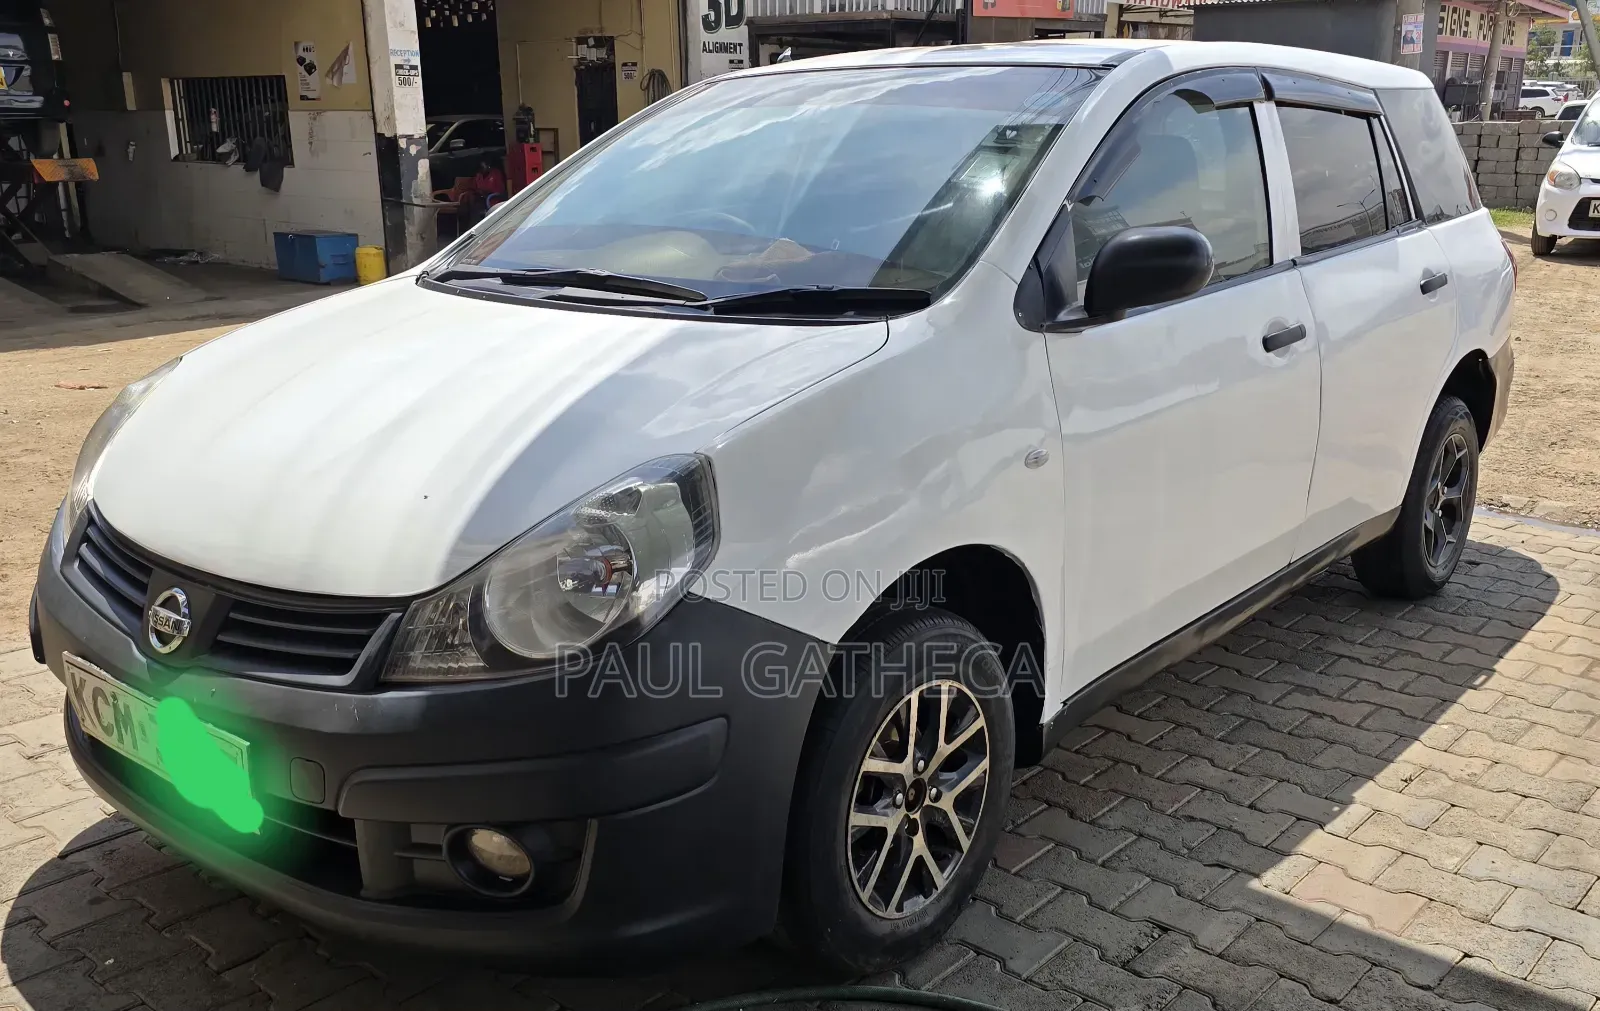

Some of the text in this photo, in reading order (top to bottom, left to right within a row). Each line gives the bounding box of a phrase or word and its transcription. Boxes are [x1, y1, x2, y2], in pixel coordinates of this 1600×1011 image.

[390, 49, 420, 57] RECEPTION
[702, 41, 743, 55] ALIGNMENT
[398, 76, 417, 86] 500/-
[152, 611, 181, 632] SSAN
[70, 671, 138, 750] KCM
